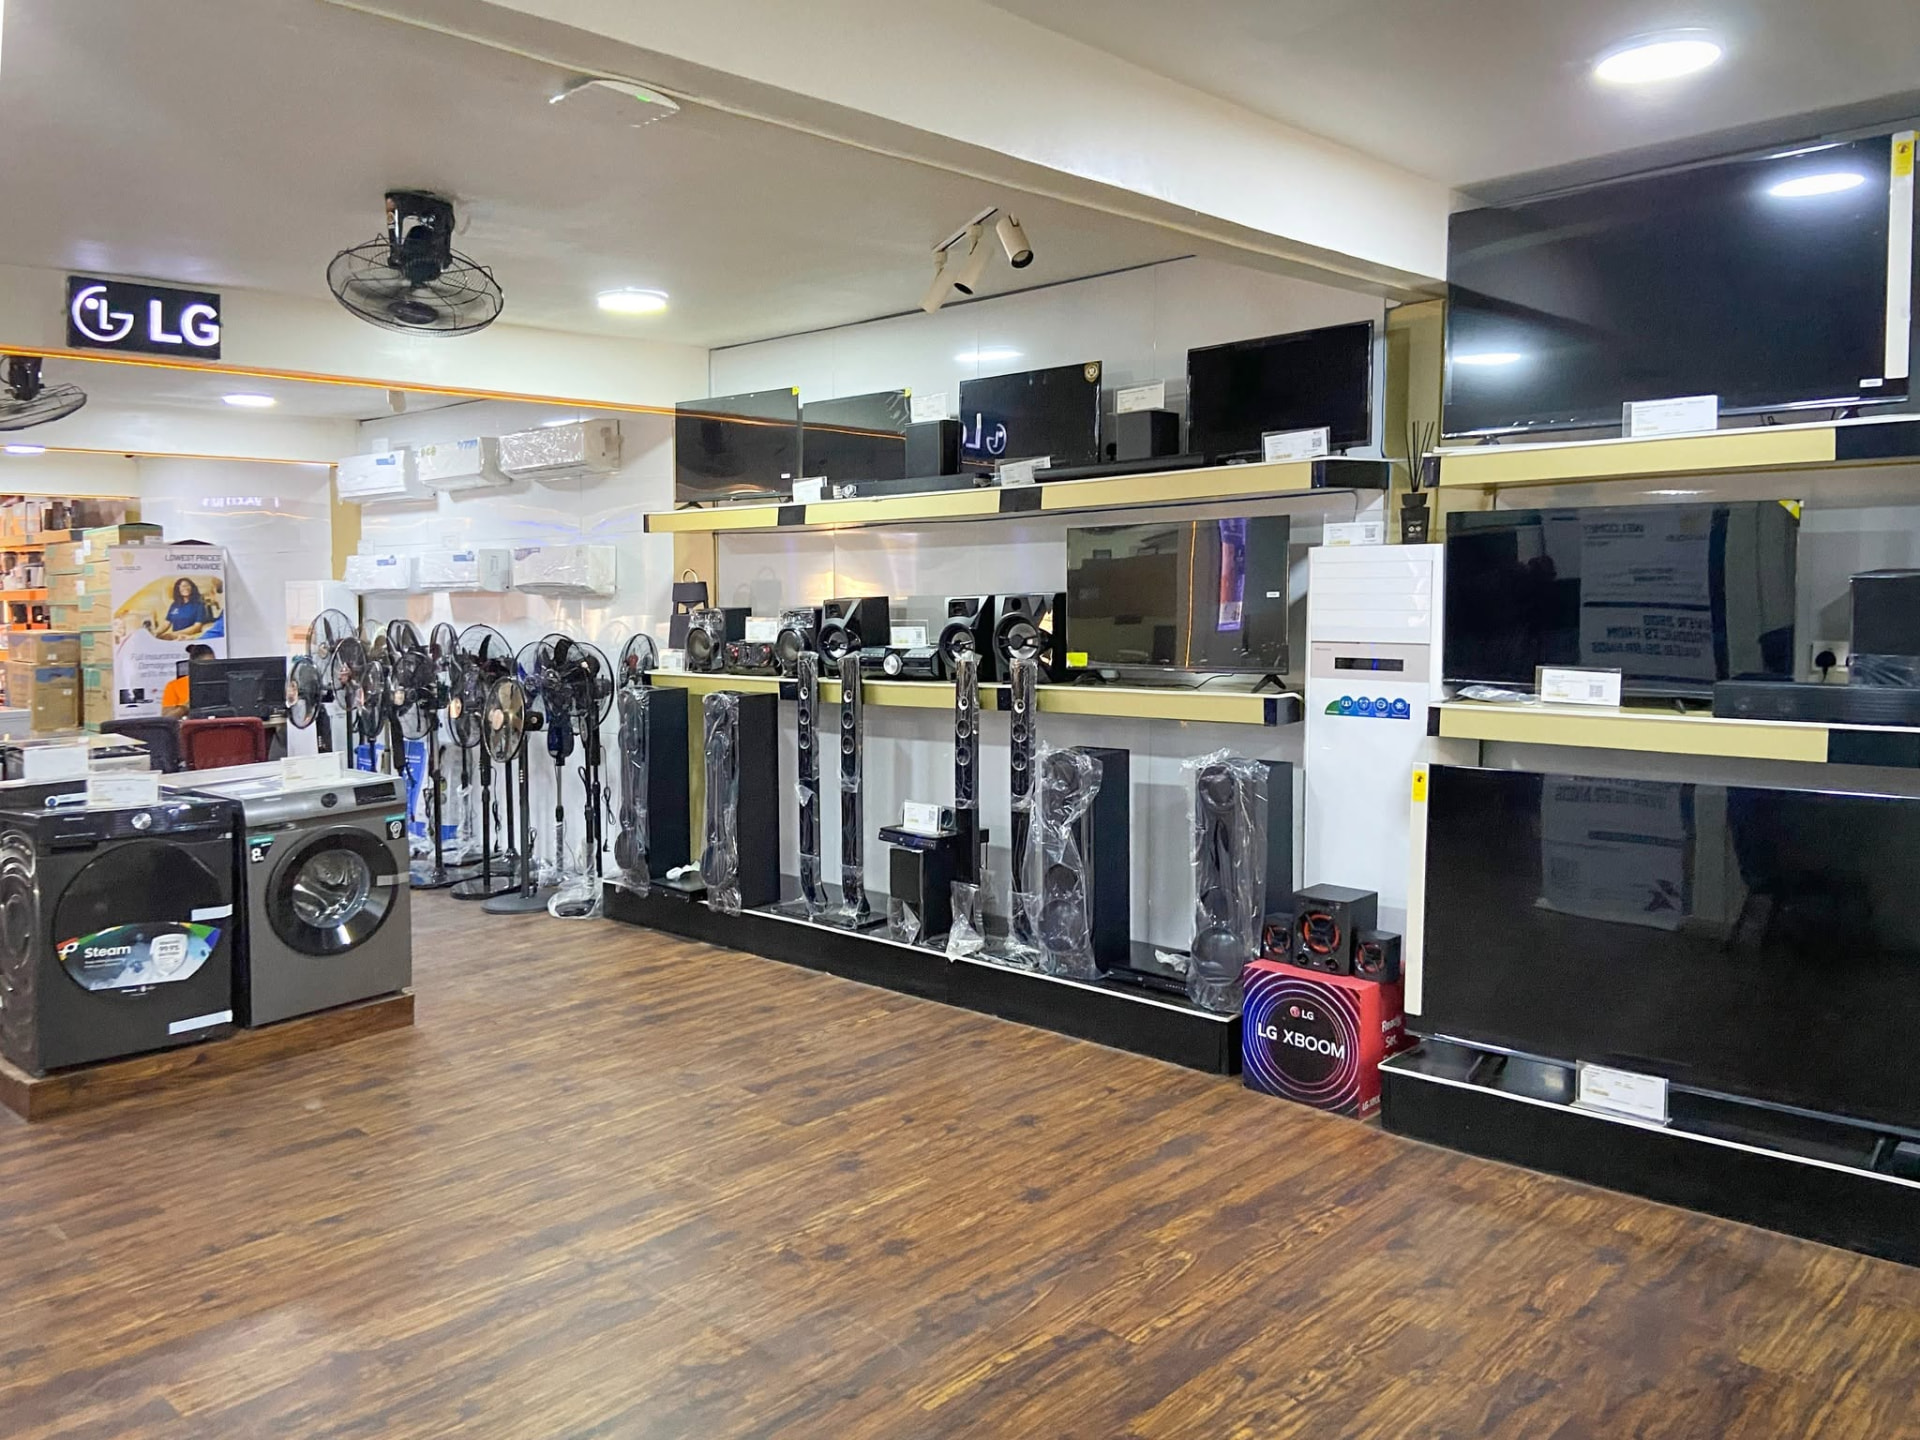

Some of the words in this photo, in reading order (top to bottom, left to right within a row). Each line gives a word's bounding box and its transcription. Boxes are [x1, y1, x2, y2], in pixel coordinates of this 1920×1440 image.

[149, 300, 220, 346] LG
[196, 554, 221, 562] PRICES
[84, 946, 131, 959] Steam
[1302, 1010, 1314, 1021] LG
[1257, 1022, 1278, 1040] LG
[1283, 1029, 1345, 1059] XBOOM
